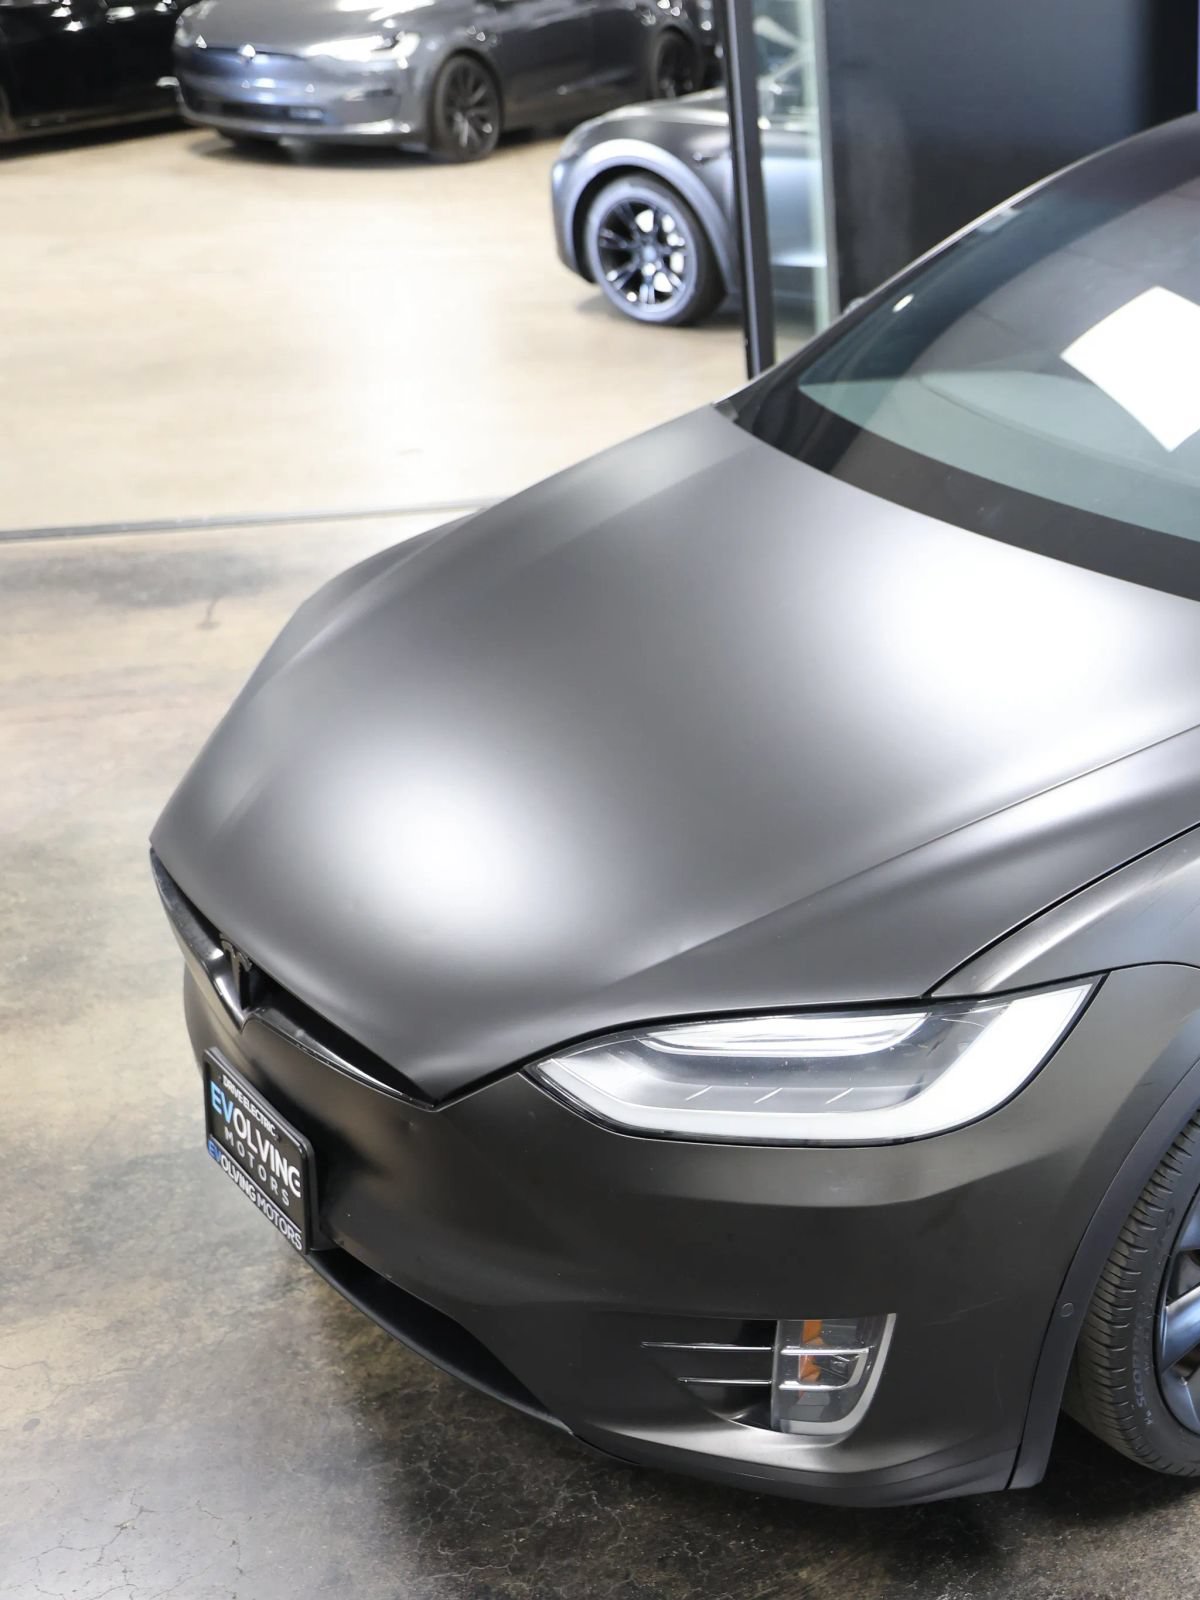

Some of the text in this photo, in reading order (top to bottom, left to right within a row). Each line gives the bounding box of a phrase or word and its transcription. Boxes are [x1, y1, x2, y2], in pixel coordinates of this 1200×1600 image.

[210, 1081, 301, 1198] EVOLVING
[223, 1075, 276, 1136] DRIVE ELECTRIC
[208, 1140, 303, 1251] EVOLVING MOTORS
[225, 1126, 290, 1207] MOTORS
